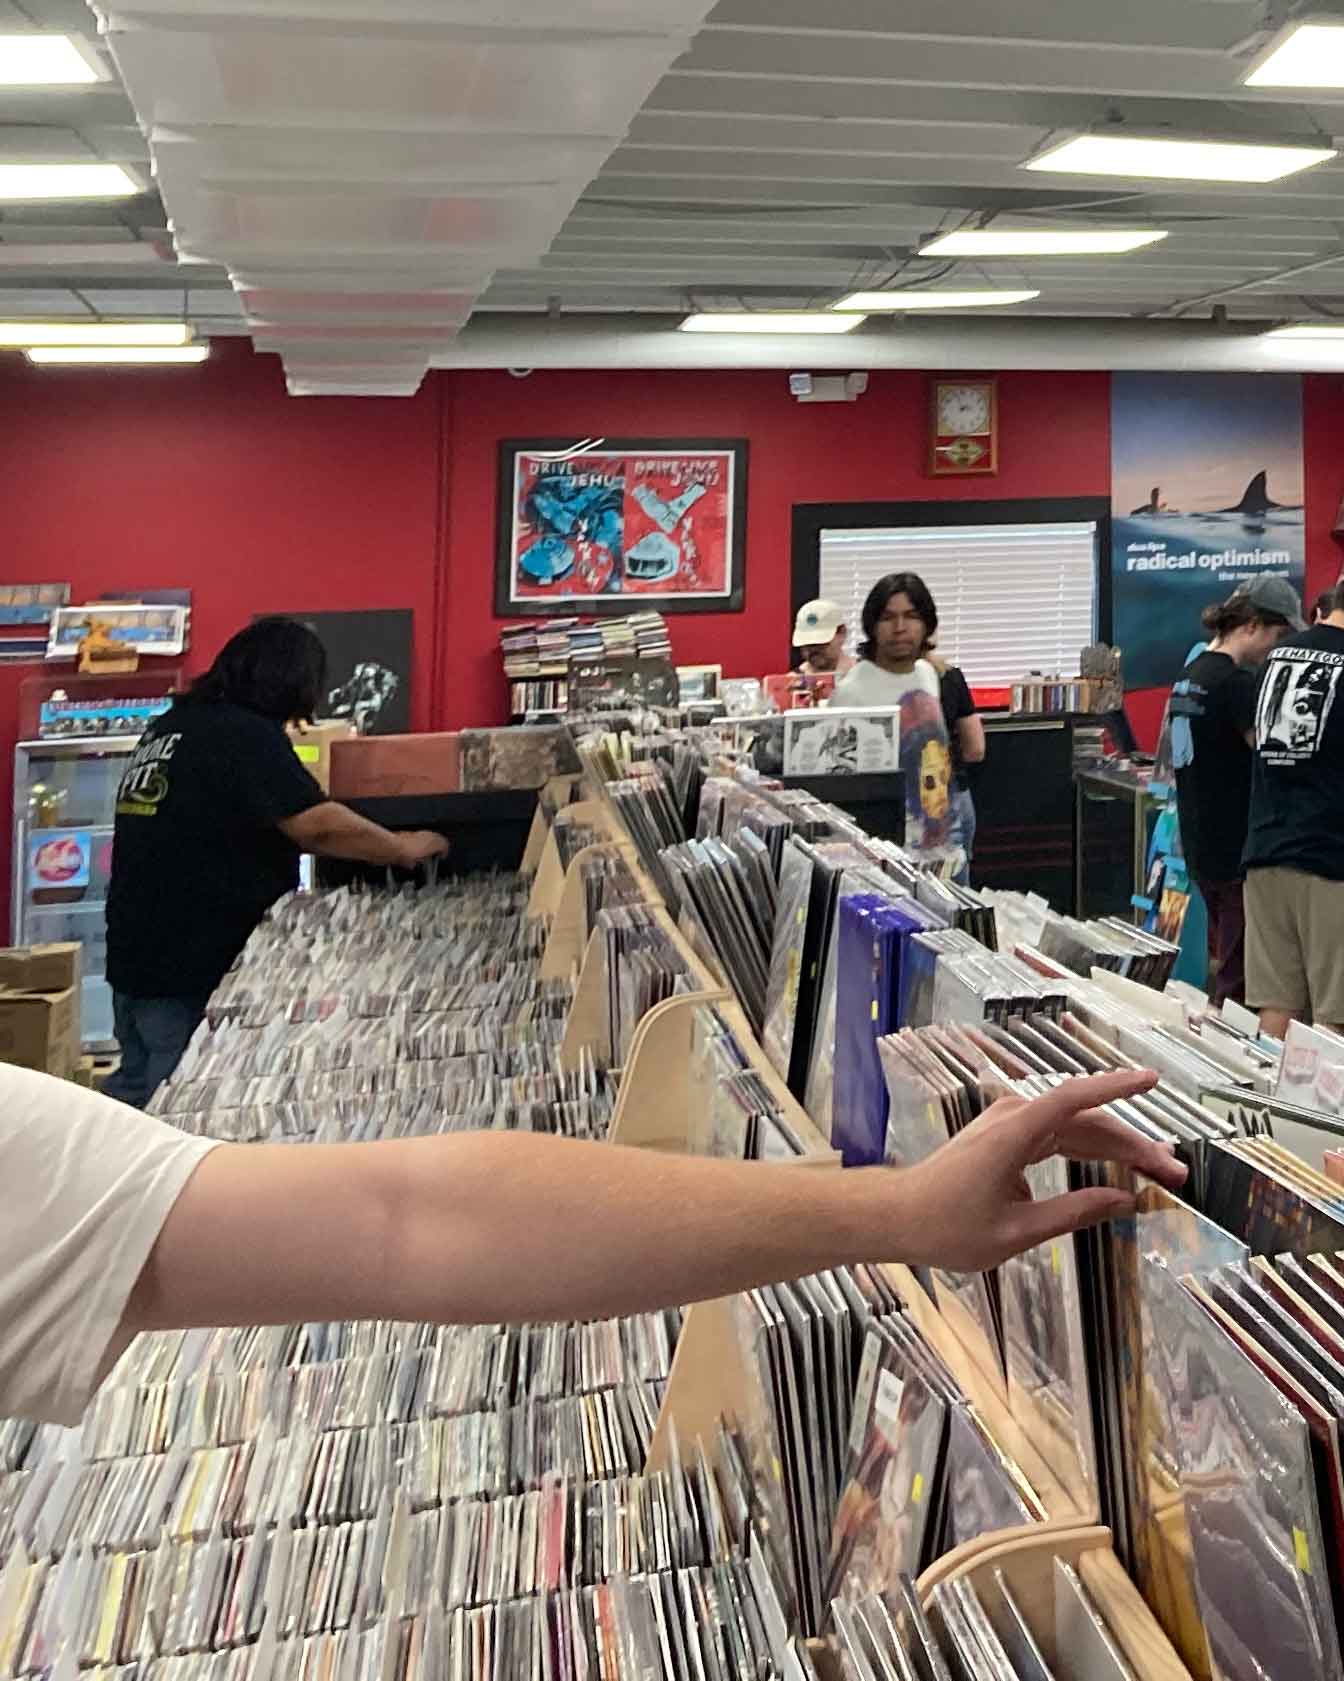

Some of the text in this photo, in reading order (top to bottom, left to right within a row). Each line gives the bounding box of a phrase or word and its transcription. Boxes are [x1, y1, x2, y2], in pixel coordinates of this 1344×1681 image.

[528, 461, 575, 476] DRIVE
[635, 459, 680, 475] DRIVE
[568, 473, 615, 488] JEHU
[1126, 548, 1291, 571] radical optimism
